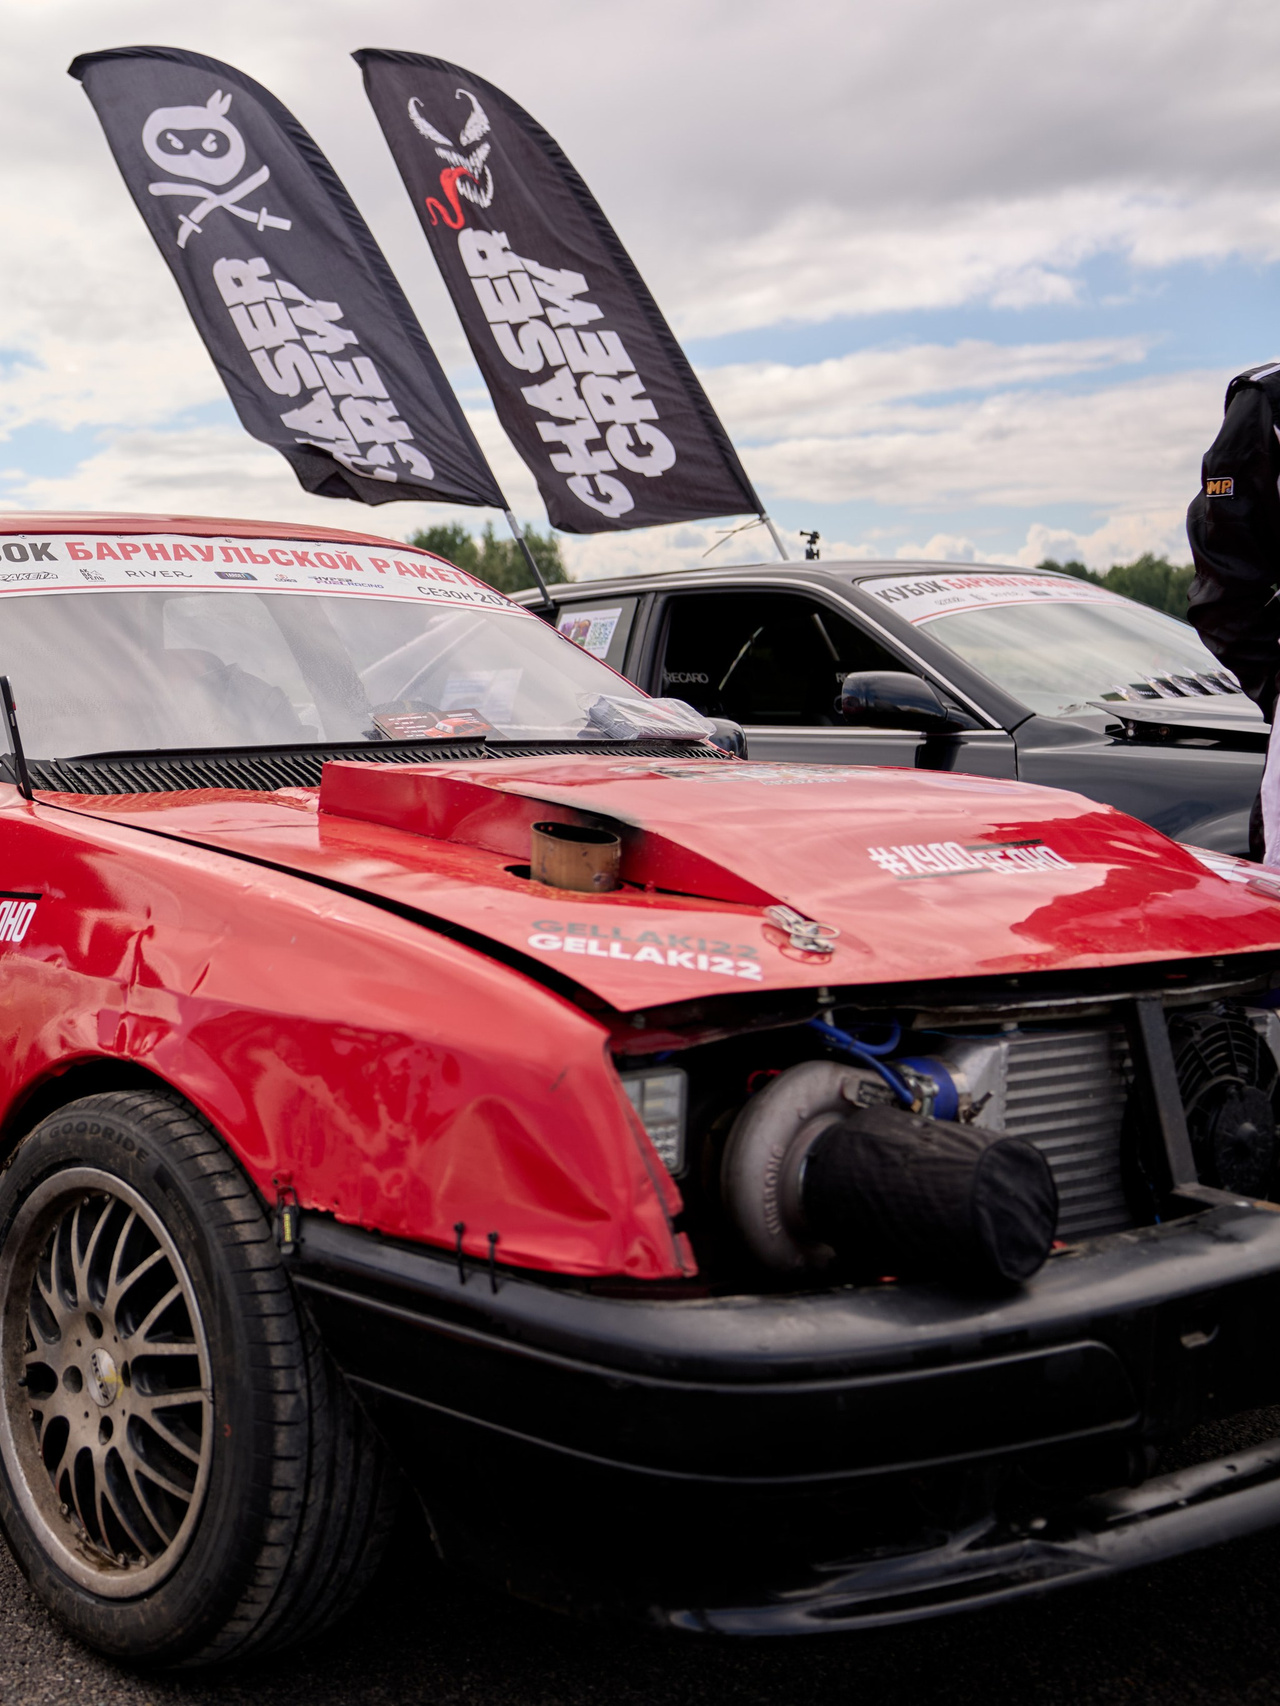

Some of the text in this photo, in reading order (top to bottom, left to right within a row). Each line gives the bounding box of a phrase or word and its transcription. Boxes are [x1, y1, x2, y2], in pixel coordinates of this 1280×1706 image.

[212, 257, 378, 468] ASER
[457, 227, 635, 518] CHASER
[511, 251, 676, 477] CREW
[1207, 480, 1231, 494] MP
[64, 542, 363, 572] БАРНАУЛЬСКОЙ
[125, 570, 193, 578] RIVER
[417, 586, 518, 609] СЕЗОН 202
[874, 580, 952, 603] КУБОК
[527, 933, 762, 981] GELLAKI22
[49, 1121, 150, 1164] GOODRIDE
